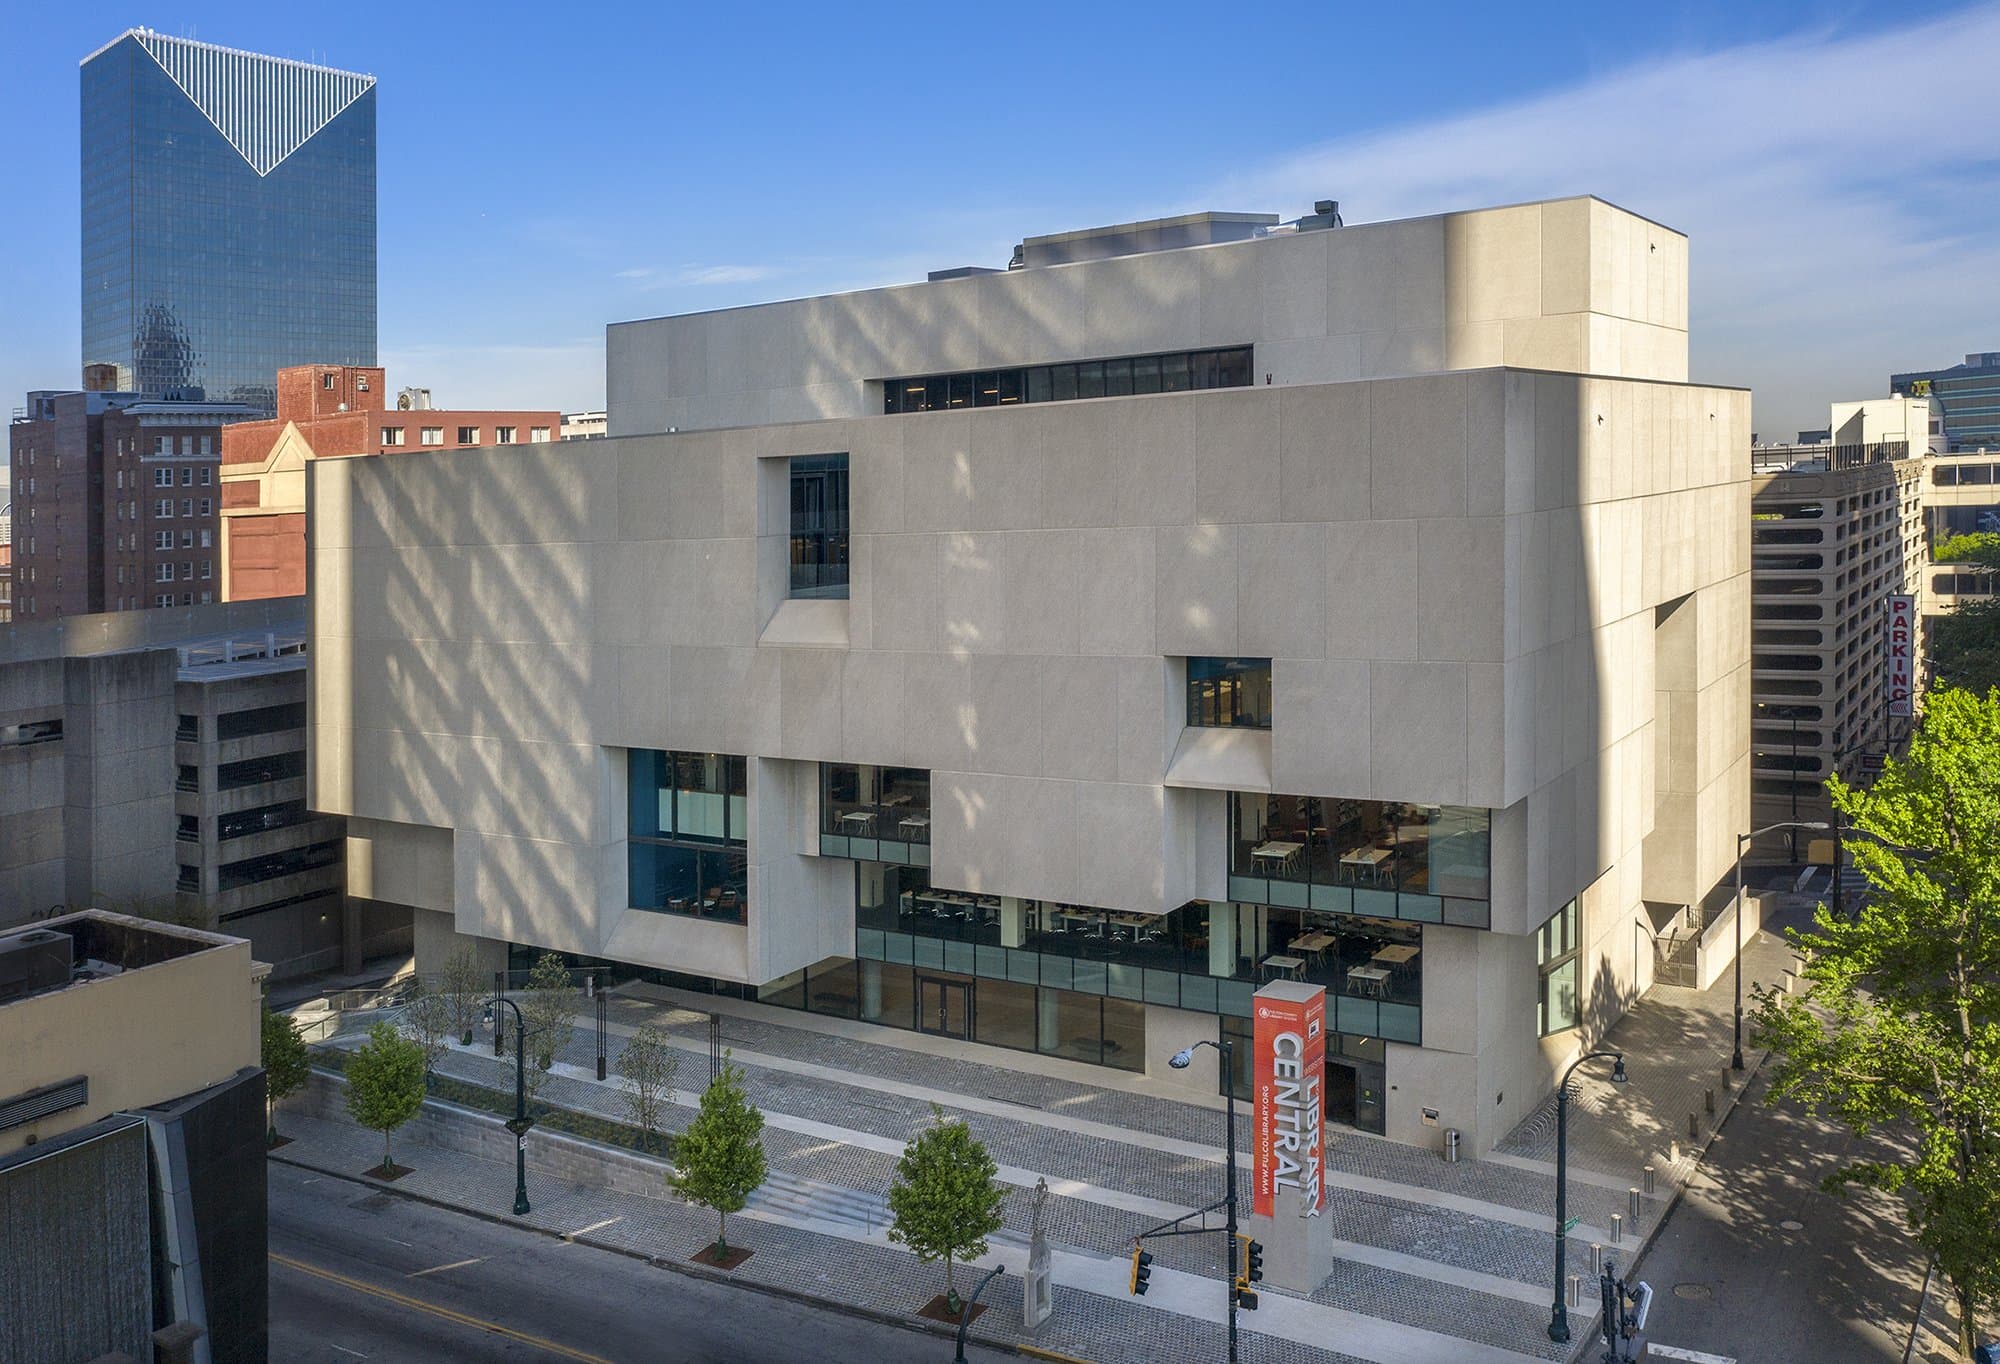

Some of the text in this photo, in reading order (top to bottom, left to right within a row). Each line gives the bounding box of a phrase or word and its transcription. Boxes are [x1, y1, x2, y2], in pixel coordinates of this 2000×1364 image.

[1892, 601, 1908, 701] PARKING
[1273, 1032, 1301, 1194] CENTRAL
[1306, 1074, 1320, 1217] LIBRARY
